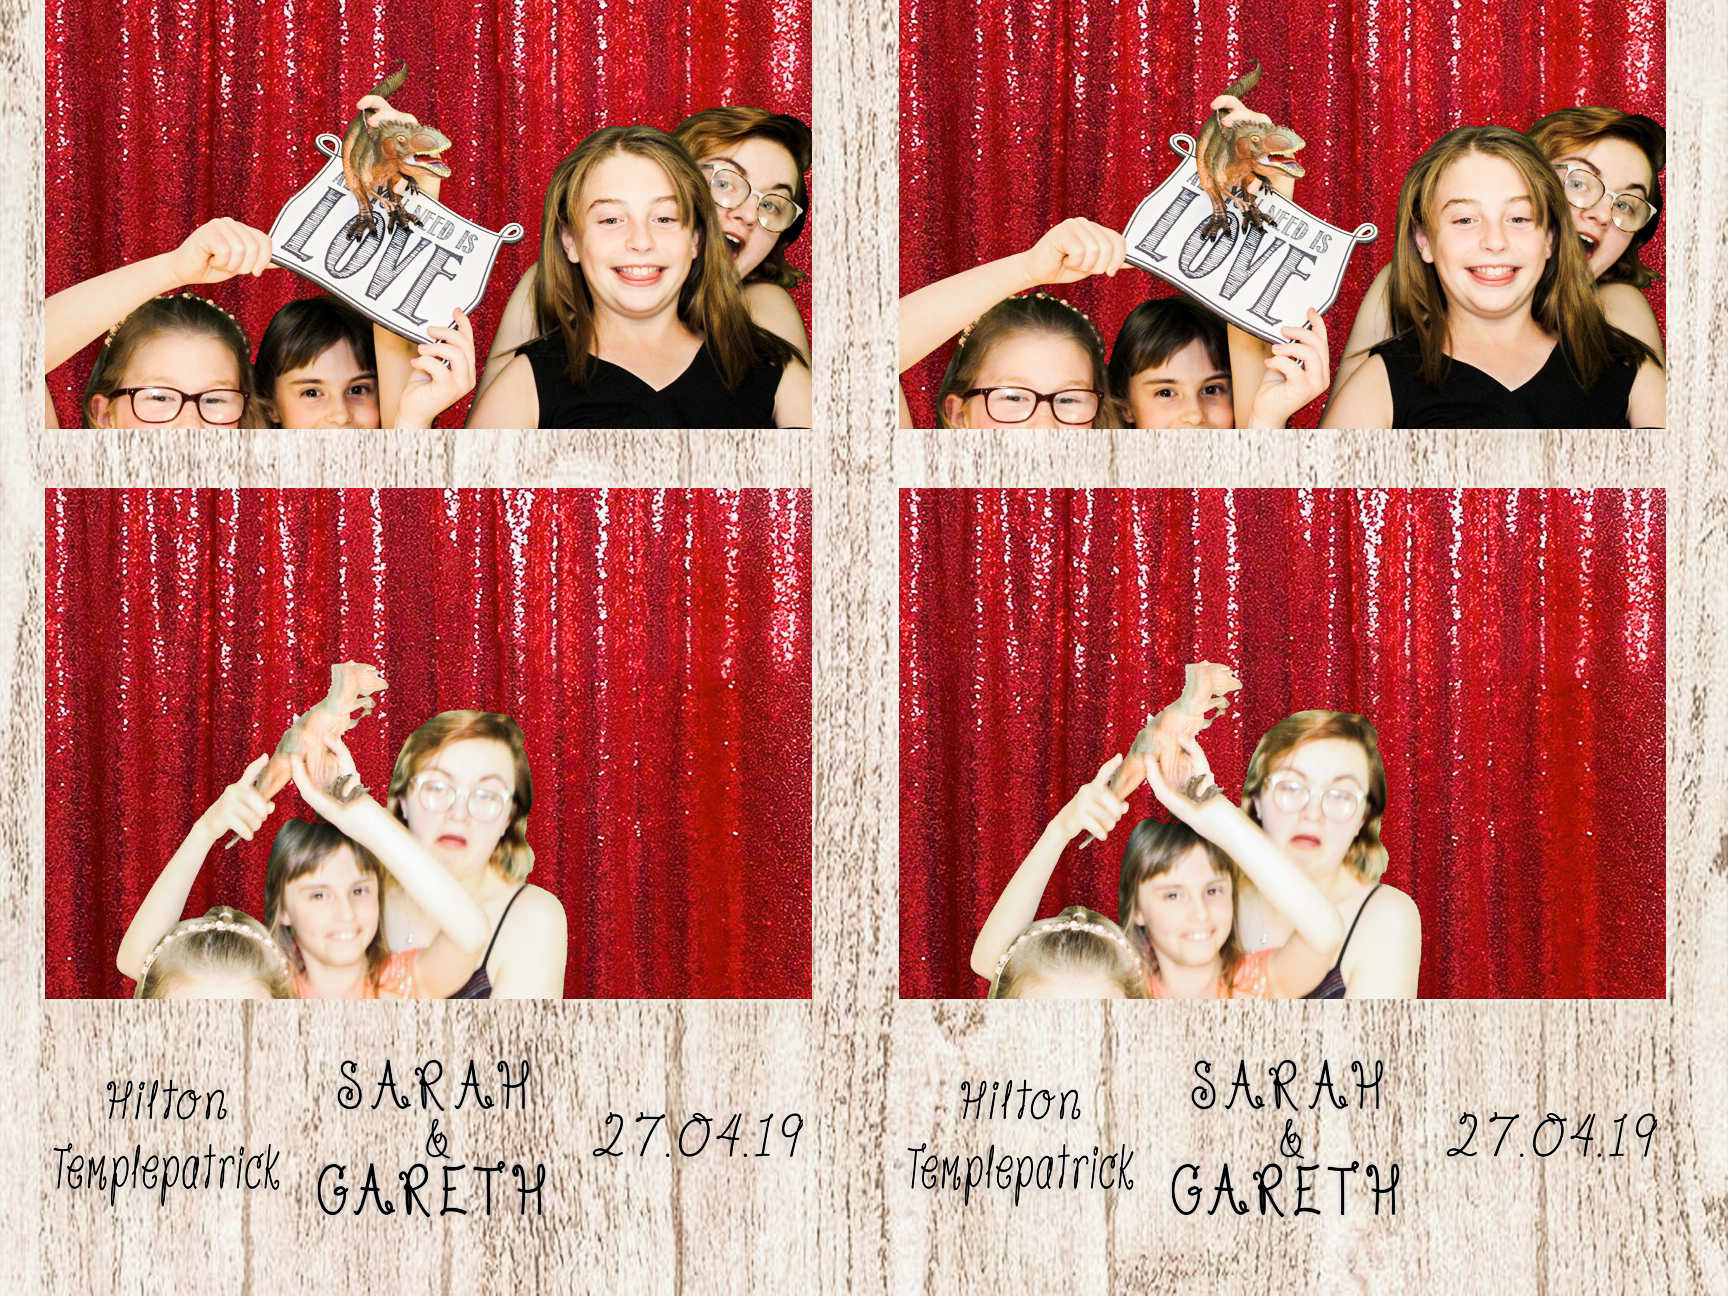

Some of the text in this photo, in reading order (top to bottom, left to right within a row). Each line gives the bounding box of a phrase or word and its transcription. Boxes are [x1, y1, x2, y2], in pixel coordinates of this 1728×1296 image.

[280, 186, 464, 327] LOVE
[412, 204, 479, 255] NEED IS
[1134, 186, 1318, 327] LOVE
[1266, 204, 1333, 255] NEED IS
